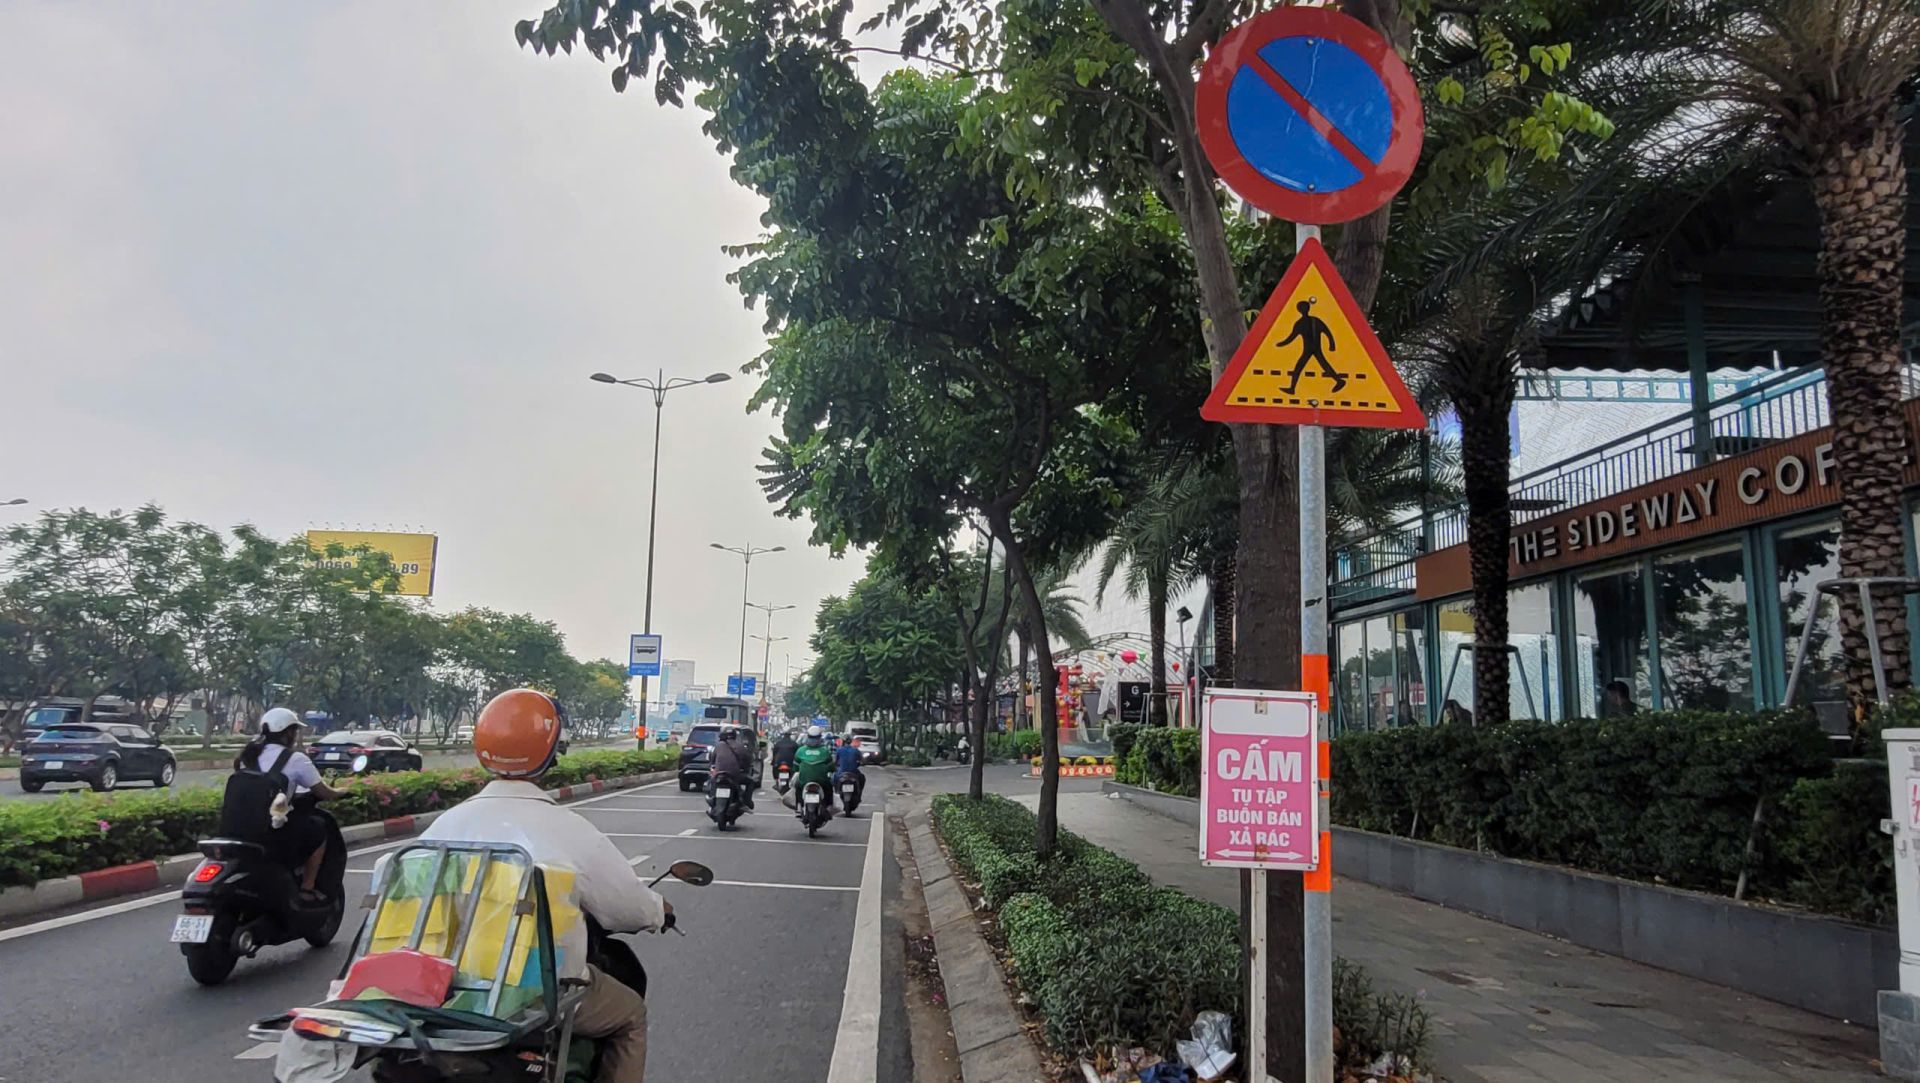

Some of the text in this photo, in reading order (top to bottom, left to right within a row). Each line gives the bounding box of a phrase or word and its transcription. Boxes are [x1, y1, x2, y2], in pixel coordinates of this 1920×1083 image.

[1509, 526, 1557, 564] THE
[1567, 479, 1716, 551] SIDEWAY
[1217, 739, 1302, 783] CẤM
[1232, 787, 1288, 807] TỤ TẬP
[1217, 807, 1302, 826] BUÔN BÁN
[1229, 826, 1290, 847] XẢ RÁC
